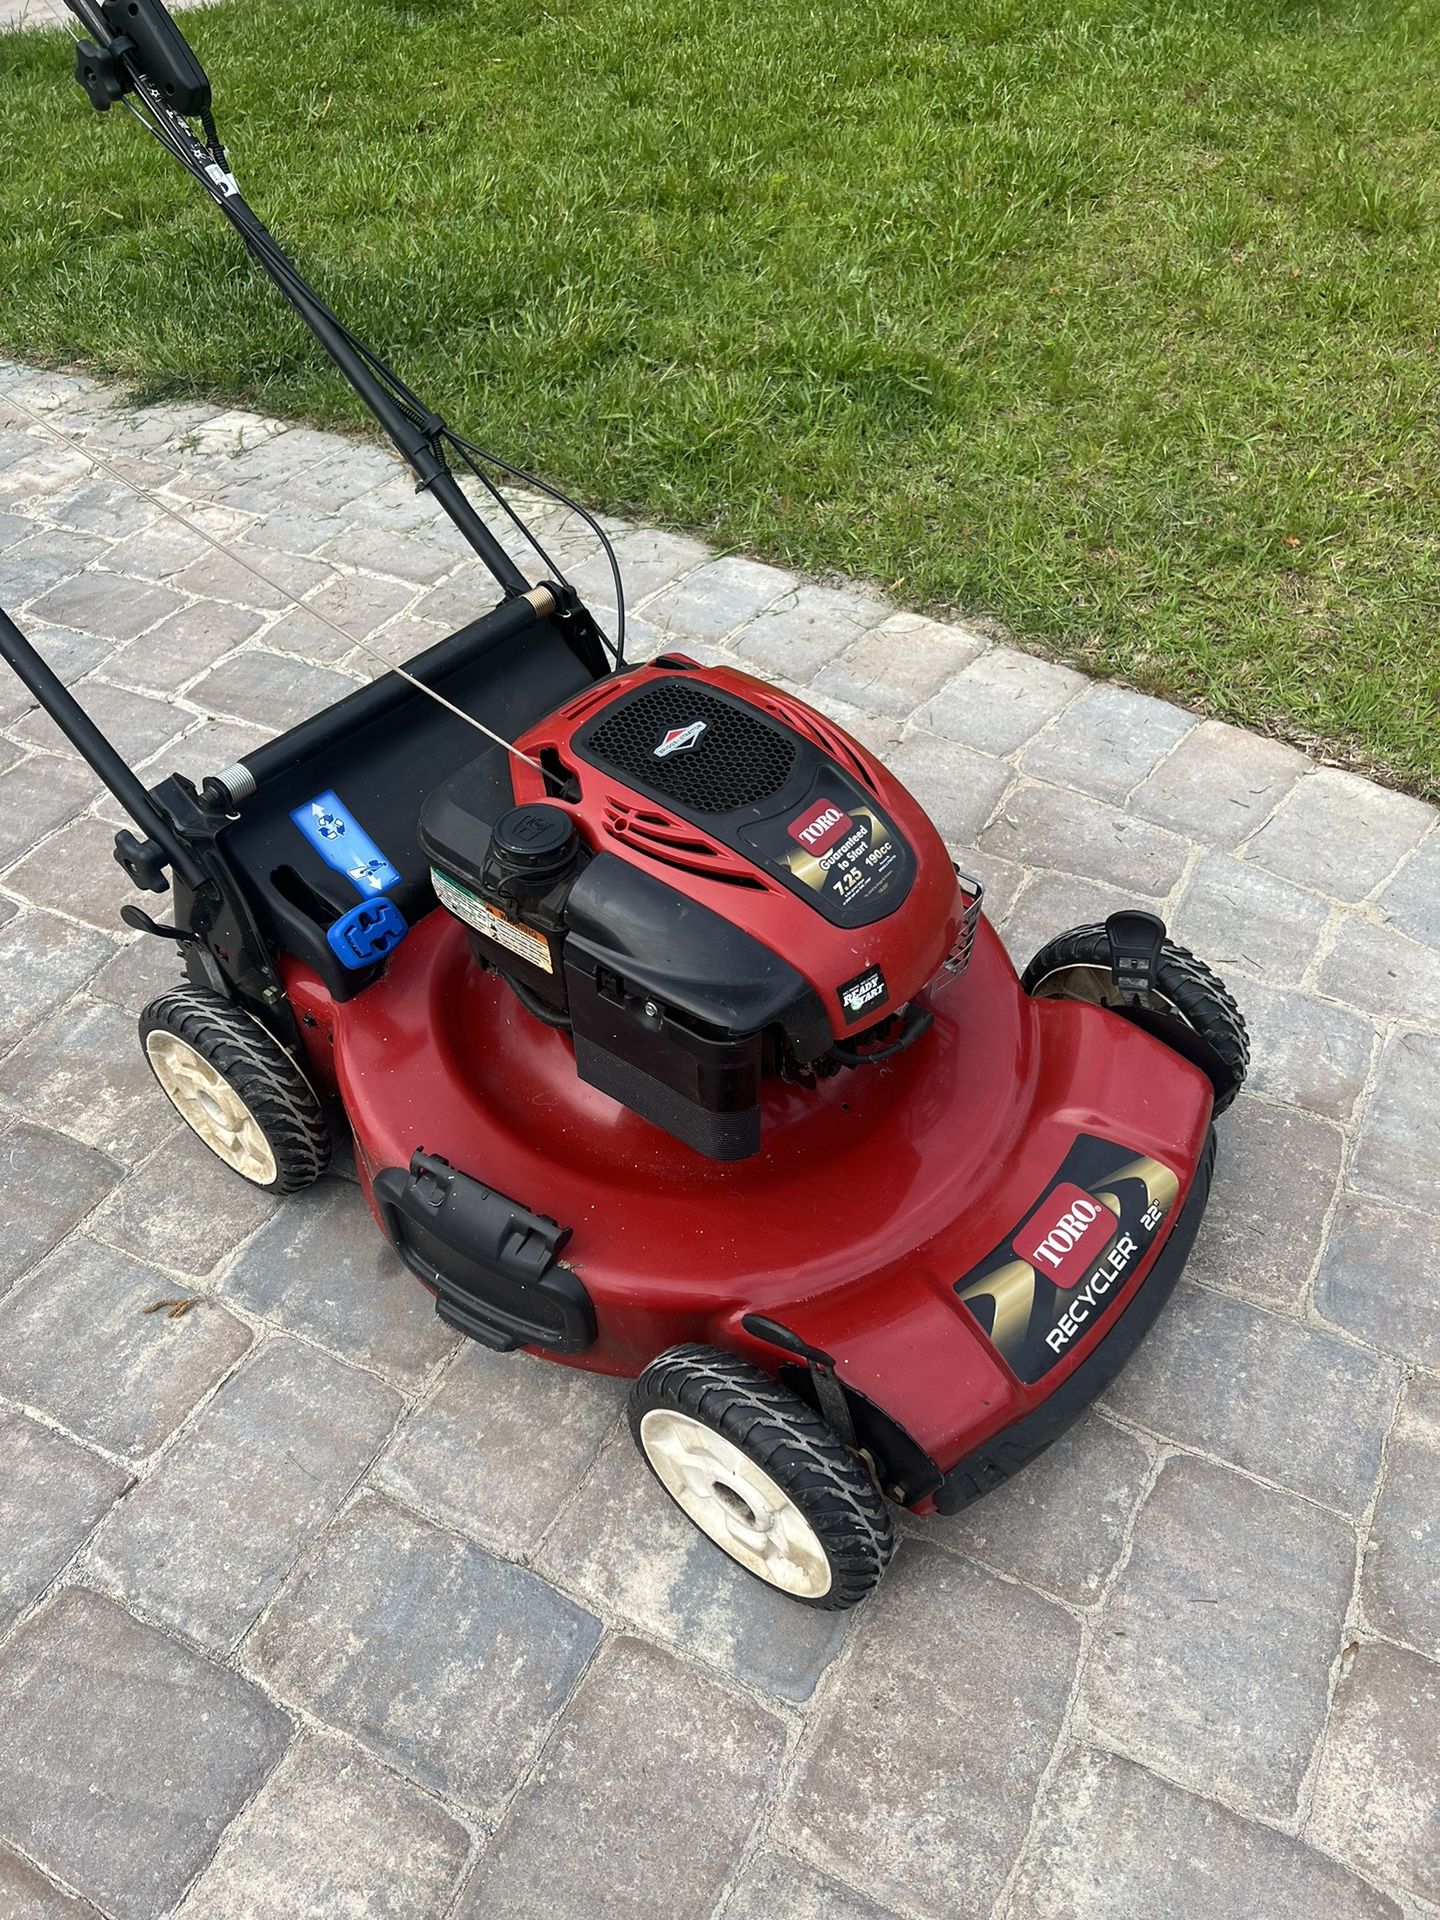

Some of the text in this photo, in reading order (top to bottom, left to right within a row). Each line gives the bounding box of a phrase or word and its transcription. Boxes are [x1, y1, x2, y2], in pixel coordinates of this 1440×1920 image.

[799, 808, 840, 844] TORO
[820, 825, 868, 869] Guaranteed
[833, 867, 862, 896] 7.25
[865, 842, 892, 866] 190cc
[838, 860, 850, 871] to
[847, 841, 868, 862] Start
[843, 976, 878, 1007] READY
[1033, 1199, 1097, 1269] TORO
[1045, 1236, 1138, 1354] RECYCLER
